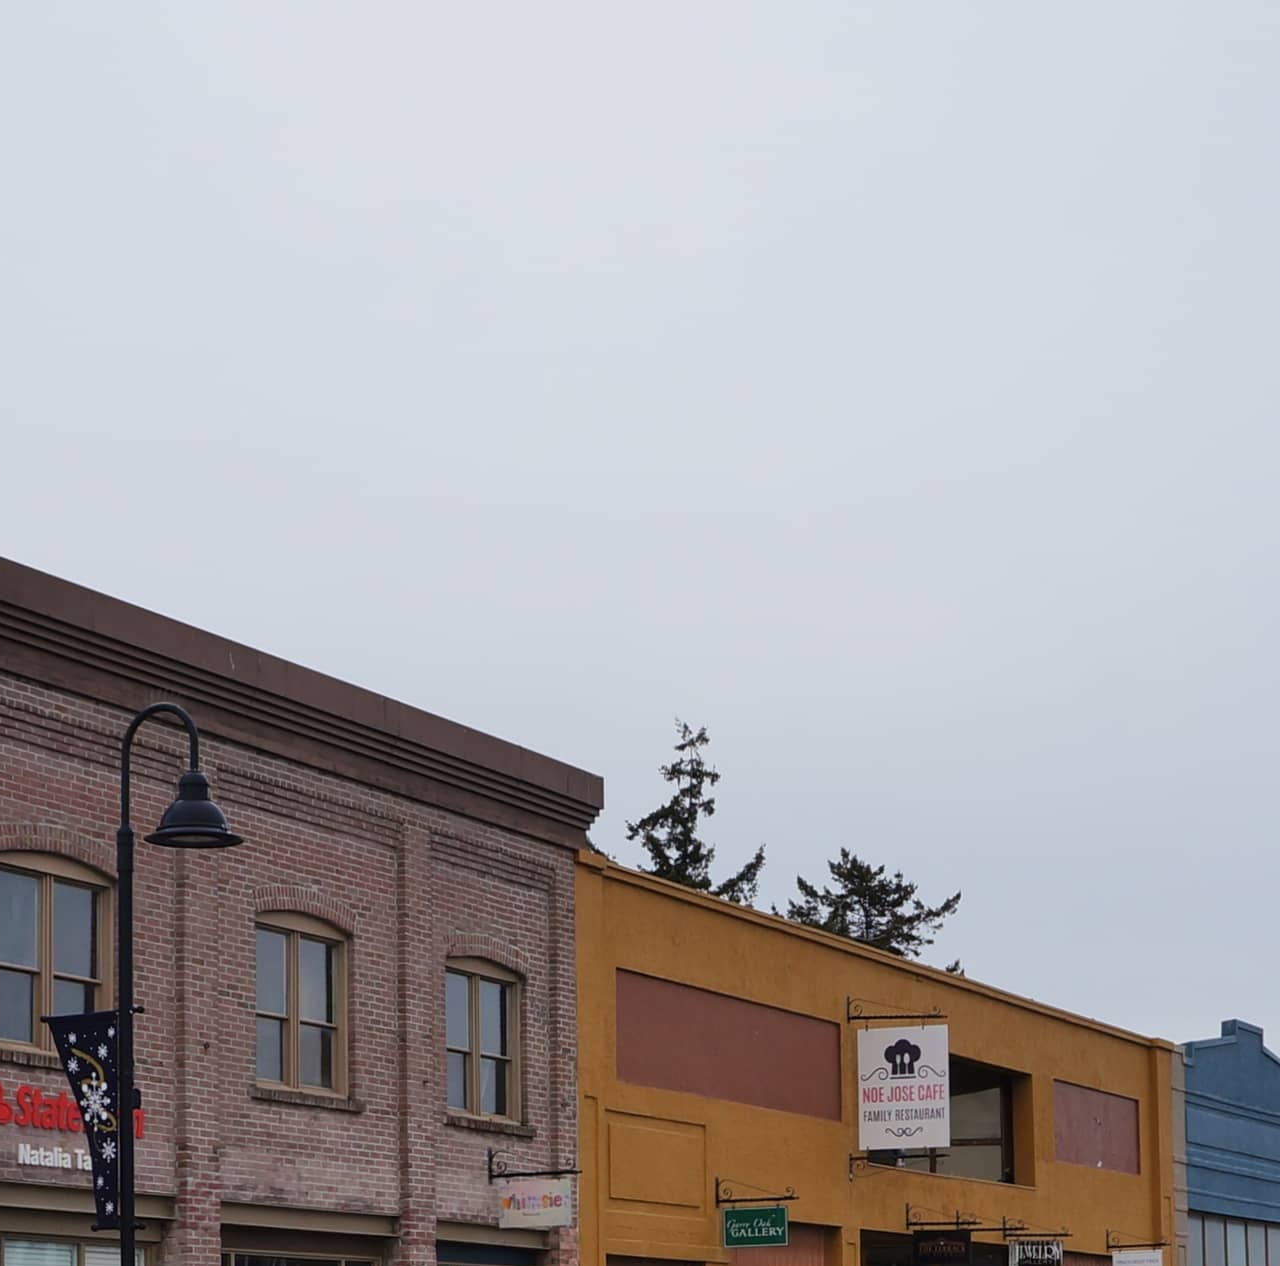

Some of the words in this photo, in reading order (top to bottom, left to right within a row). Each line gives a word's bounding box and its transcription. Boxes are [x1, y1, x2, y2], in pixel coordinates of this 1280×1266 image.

[862, 1087, 885, 1104] NOE
[887, 1085, 916, 1103] JOSE
[918, 1083, 945, 1101] CAFE
[863, 1109, 892, 1123] FAMILY
[895, 1107, 945, 1121] RESTAURANT
[17, 1143, 72, 1169] Natalia
[74, 1149, 93, 1171] Ta
[730, 1226, 785, 1239] GALLERY
